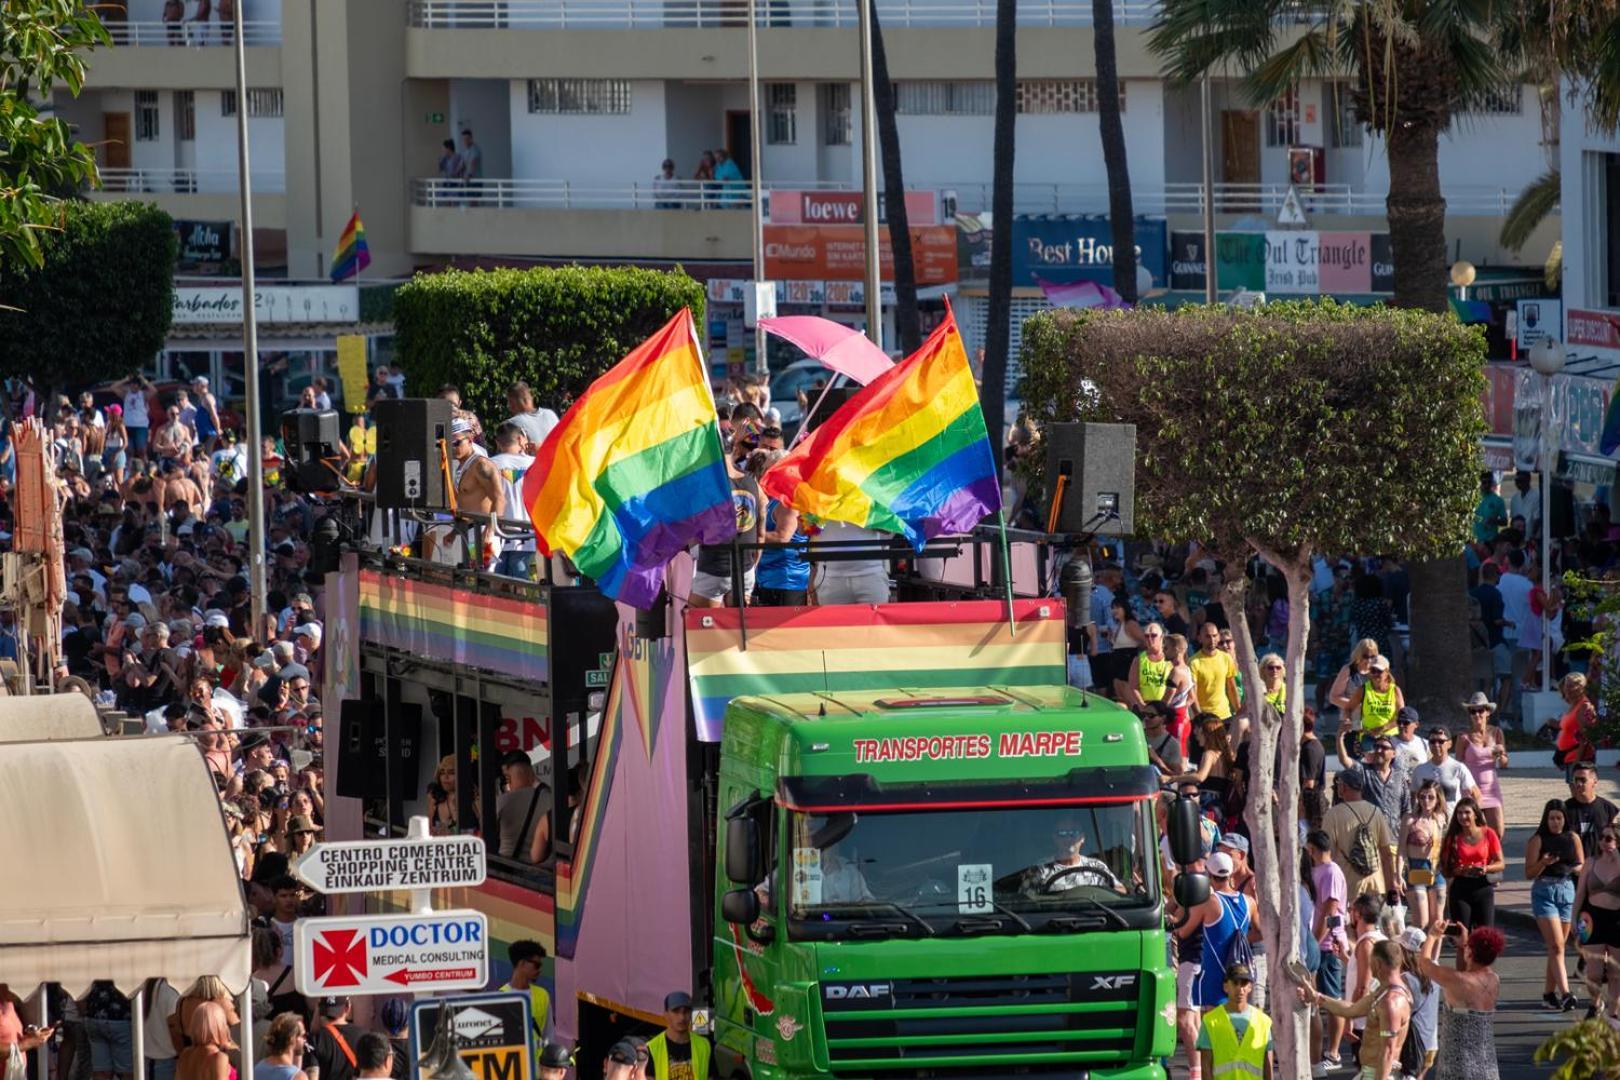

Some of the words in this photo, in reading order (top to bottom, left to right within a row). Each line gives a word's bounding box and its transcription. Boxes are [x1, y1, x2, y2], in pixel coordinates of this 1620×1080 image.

[805, 196, 858, 219] loewe
[1027, 237, 1073, 264] Best
[1295, 238, 1365, 269] Triangle
[1172, 261, 1207, 274] GUINNES
[854, 734, 991, 762] TRANSPORTES
[998, 731, 1083, 757] MARPE
[320, 848, 383, 864] CENTRO
[388, 842, 481, 860] COMERCIAL
[326, 859, 408, 876] SHOPPING
[414, 855, 475, 871] CENTRE
[325, 872, 394, 889] EINKAUF
[399, 868, 478, 885] ZENTRUM
[964, 886, 986, 909] 16
[370, 921, 481, 948] DOCTOR
[372, 952, 417, 966] MEDICAL
[419, 950, 485, 963] CONSULTING
[404, 971, 433, 981] YUMBO
[434, 970, 473, 979] CENTRUM
[1089, 975, 1136, 990] XF
[825, 984, 889, 999] DAF
[456, 1018, 492, 1029] uronet
[461, 1051, 522, 1080] TM
